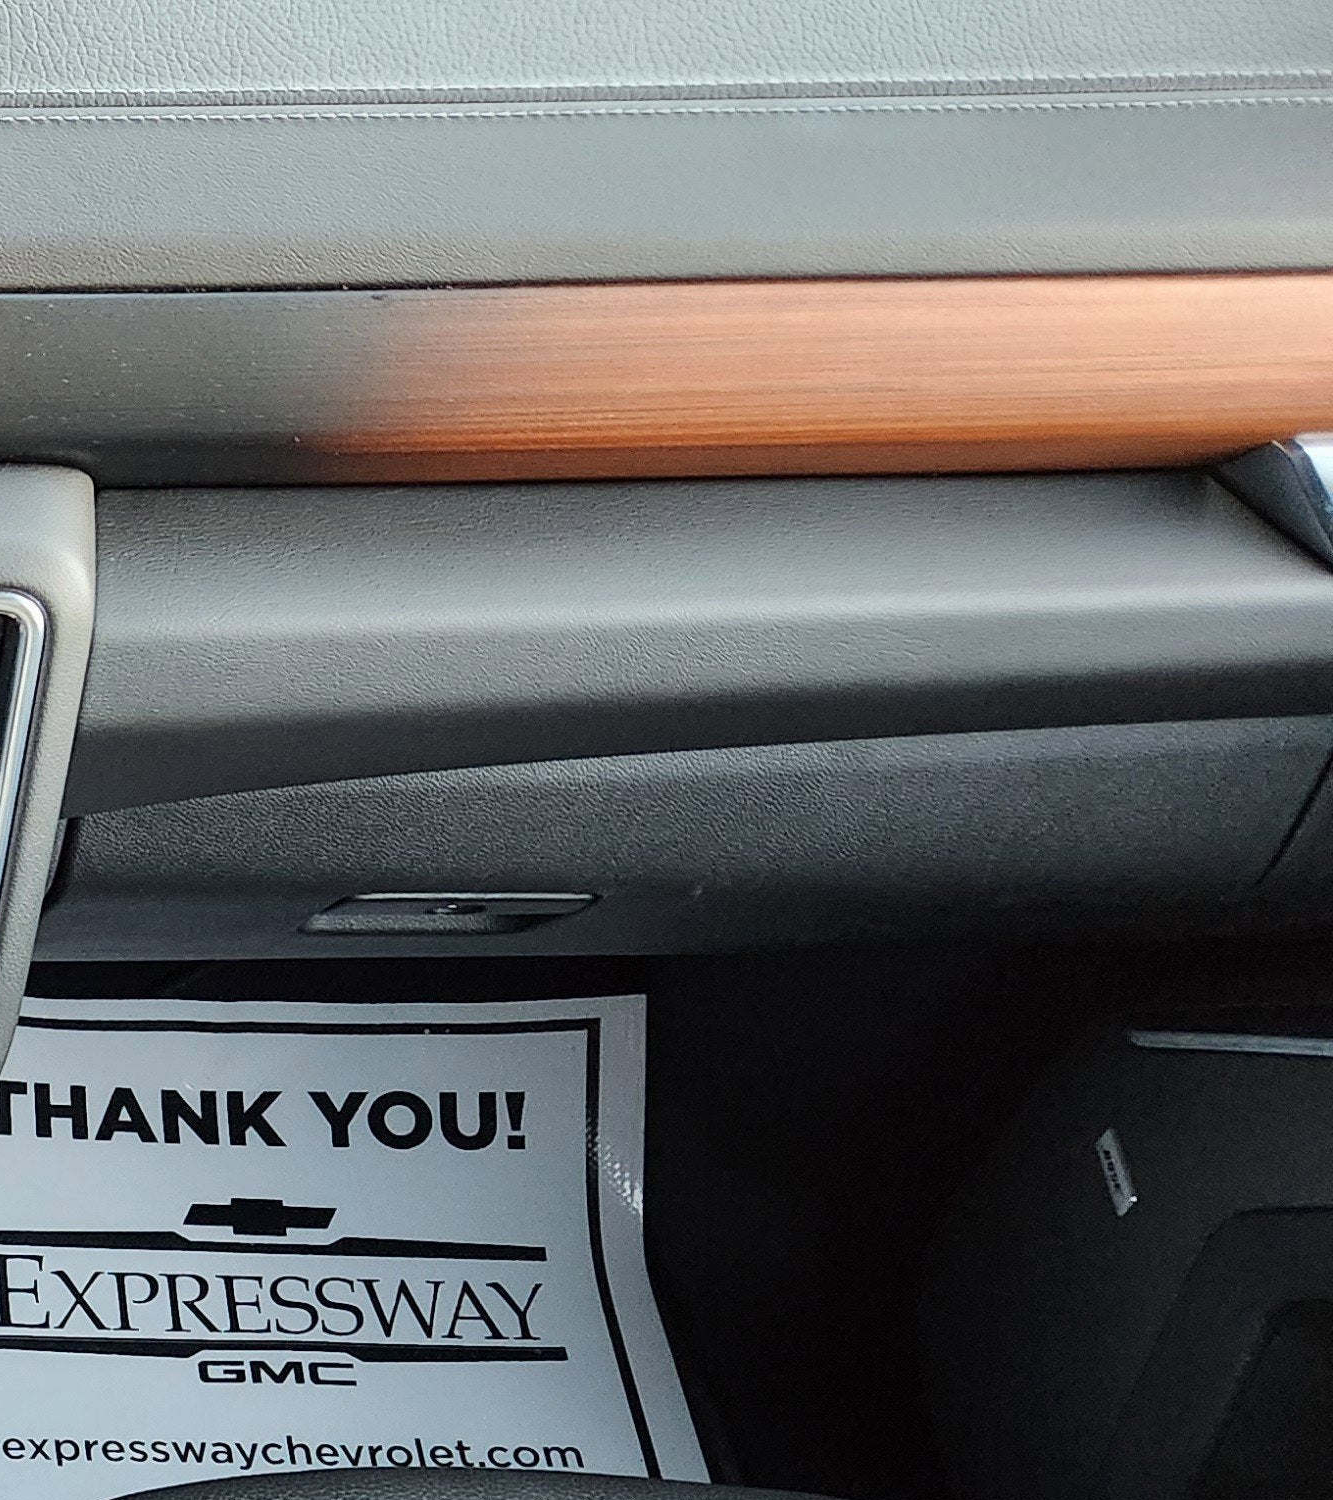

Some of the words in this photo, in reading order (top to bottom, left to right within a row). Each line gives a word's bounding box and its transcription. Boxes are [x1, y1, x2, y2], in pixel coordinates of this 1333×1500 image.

[308, 1090, 527, 1151] YOU!
[197, 1359, 358, 1387] GMC
[0, 1434, 585, 1471] expresswaychevrolet.com
